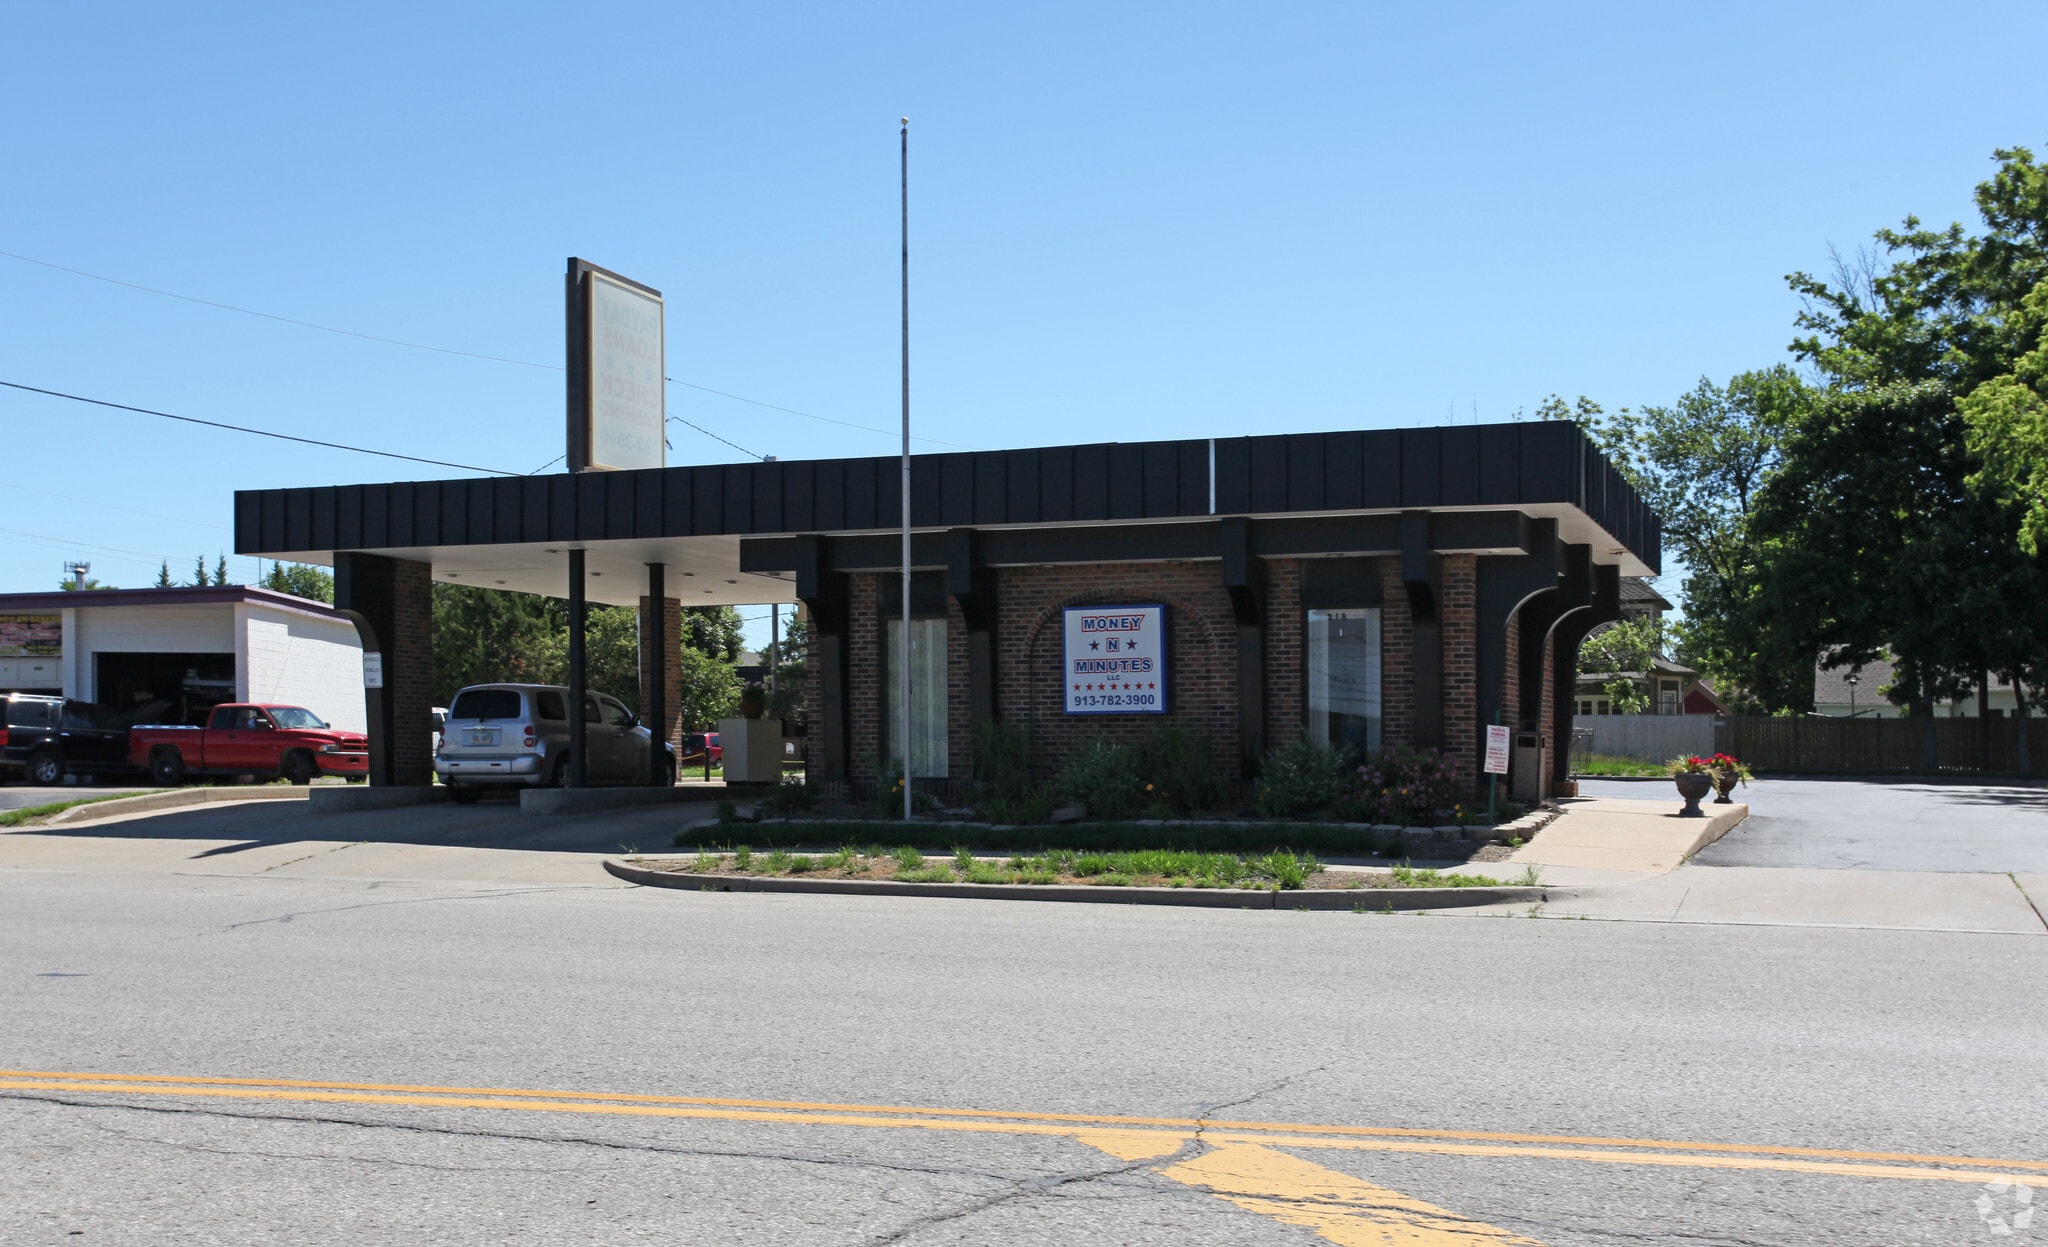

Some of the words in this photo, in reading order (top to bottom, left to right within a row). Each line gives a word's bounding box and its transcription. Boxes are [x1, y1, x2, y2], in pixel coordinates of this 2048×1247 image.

[1083, 616, 1143, 631] MONEY
[1107, 639, 1118, 651] N
[1075, 658, 1152, 673] MINUTES
[1074, 694, 1155, 706] 913-782-3900
